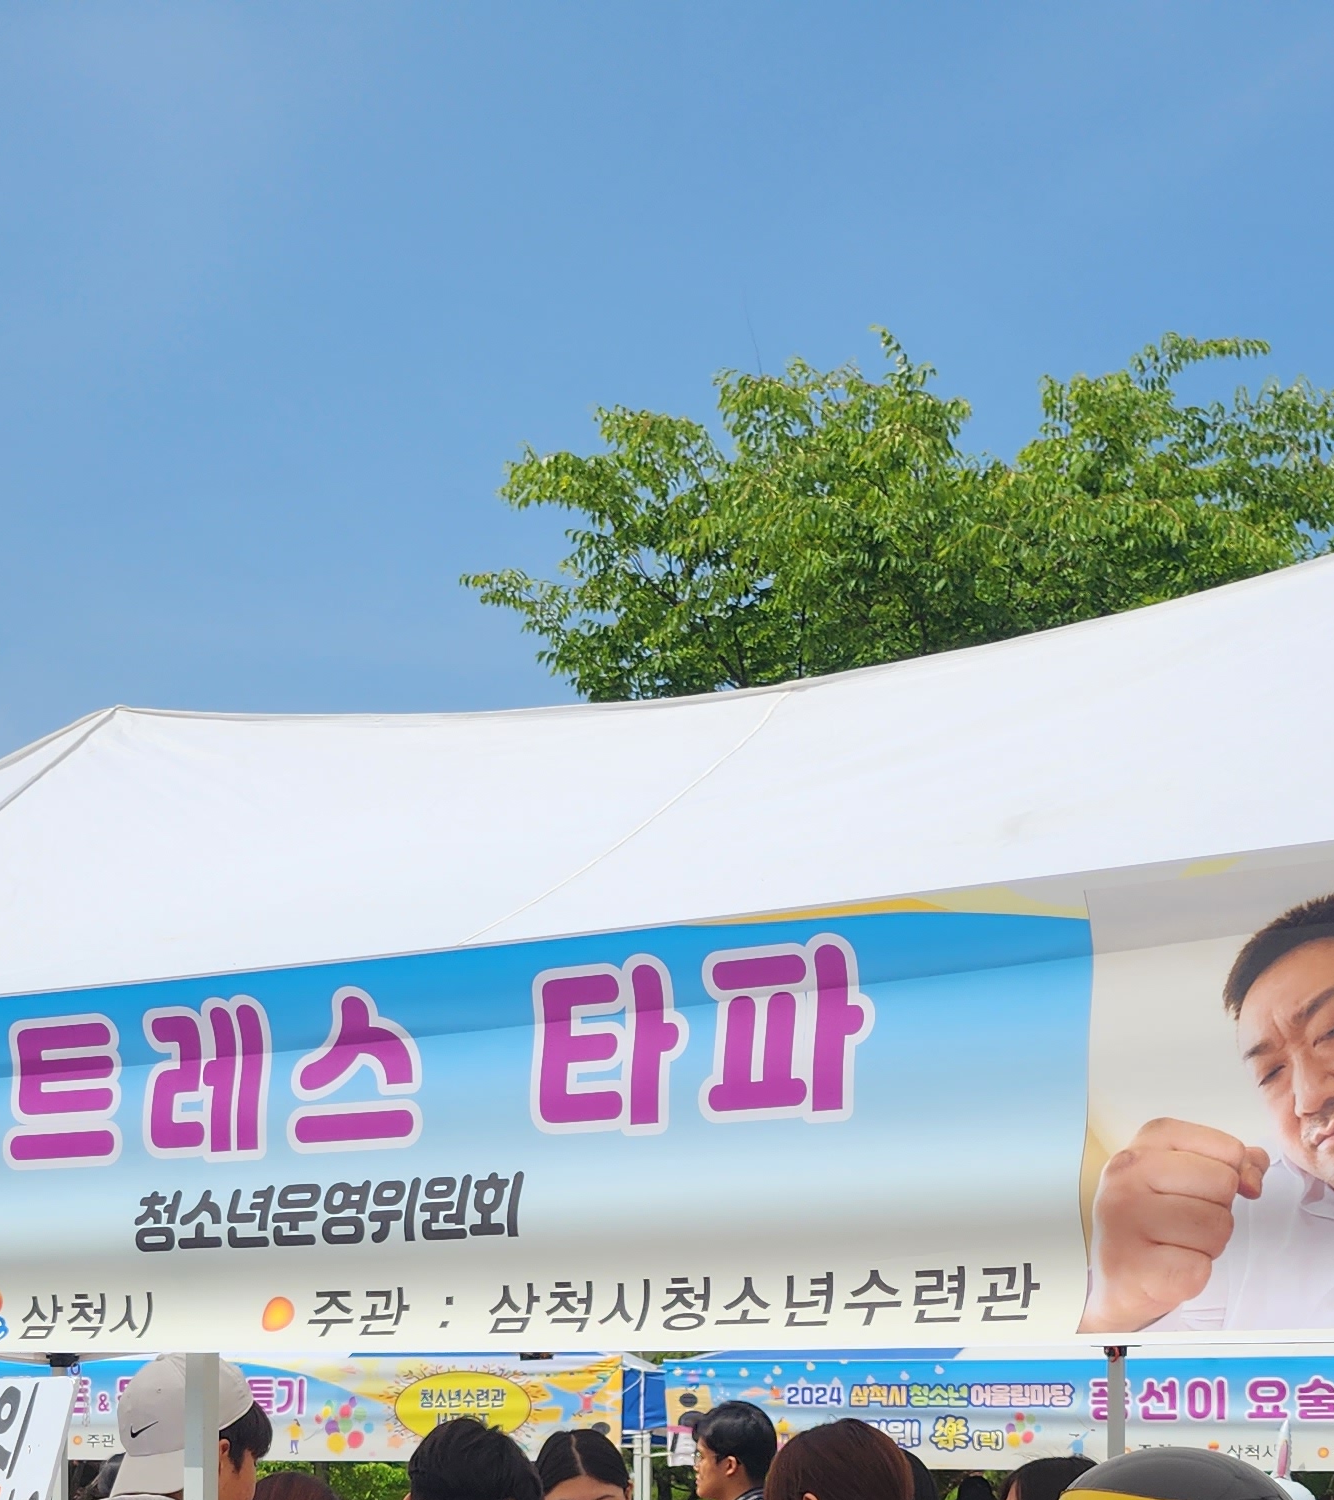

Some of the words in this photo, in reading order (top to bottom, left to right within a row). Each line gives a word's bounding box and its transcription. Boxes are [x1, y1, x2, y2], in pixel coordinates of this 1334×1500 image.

[535, 942, 871, 1124] 타파
[134, 1170, 522, 1252] 청소년운영위원회
[18, 1292, 153, 1340] 삼척시
[307, 1287, 409, 1337] 주관
[488, 1262, 1041, 1336] 삼척시청소년수련관
[420, 1388, 507, 1408] 청소년수련관
[787, 1386, 843, 1405] 2024
[850, 1384, 907, 1407] 삼척시
[908, 1383, 969, 1407] 청소년
[969, 1383, 1074, 1408] 어울림마당
[86, 1433, 116, 1448] 주관
